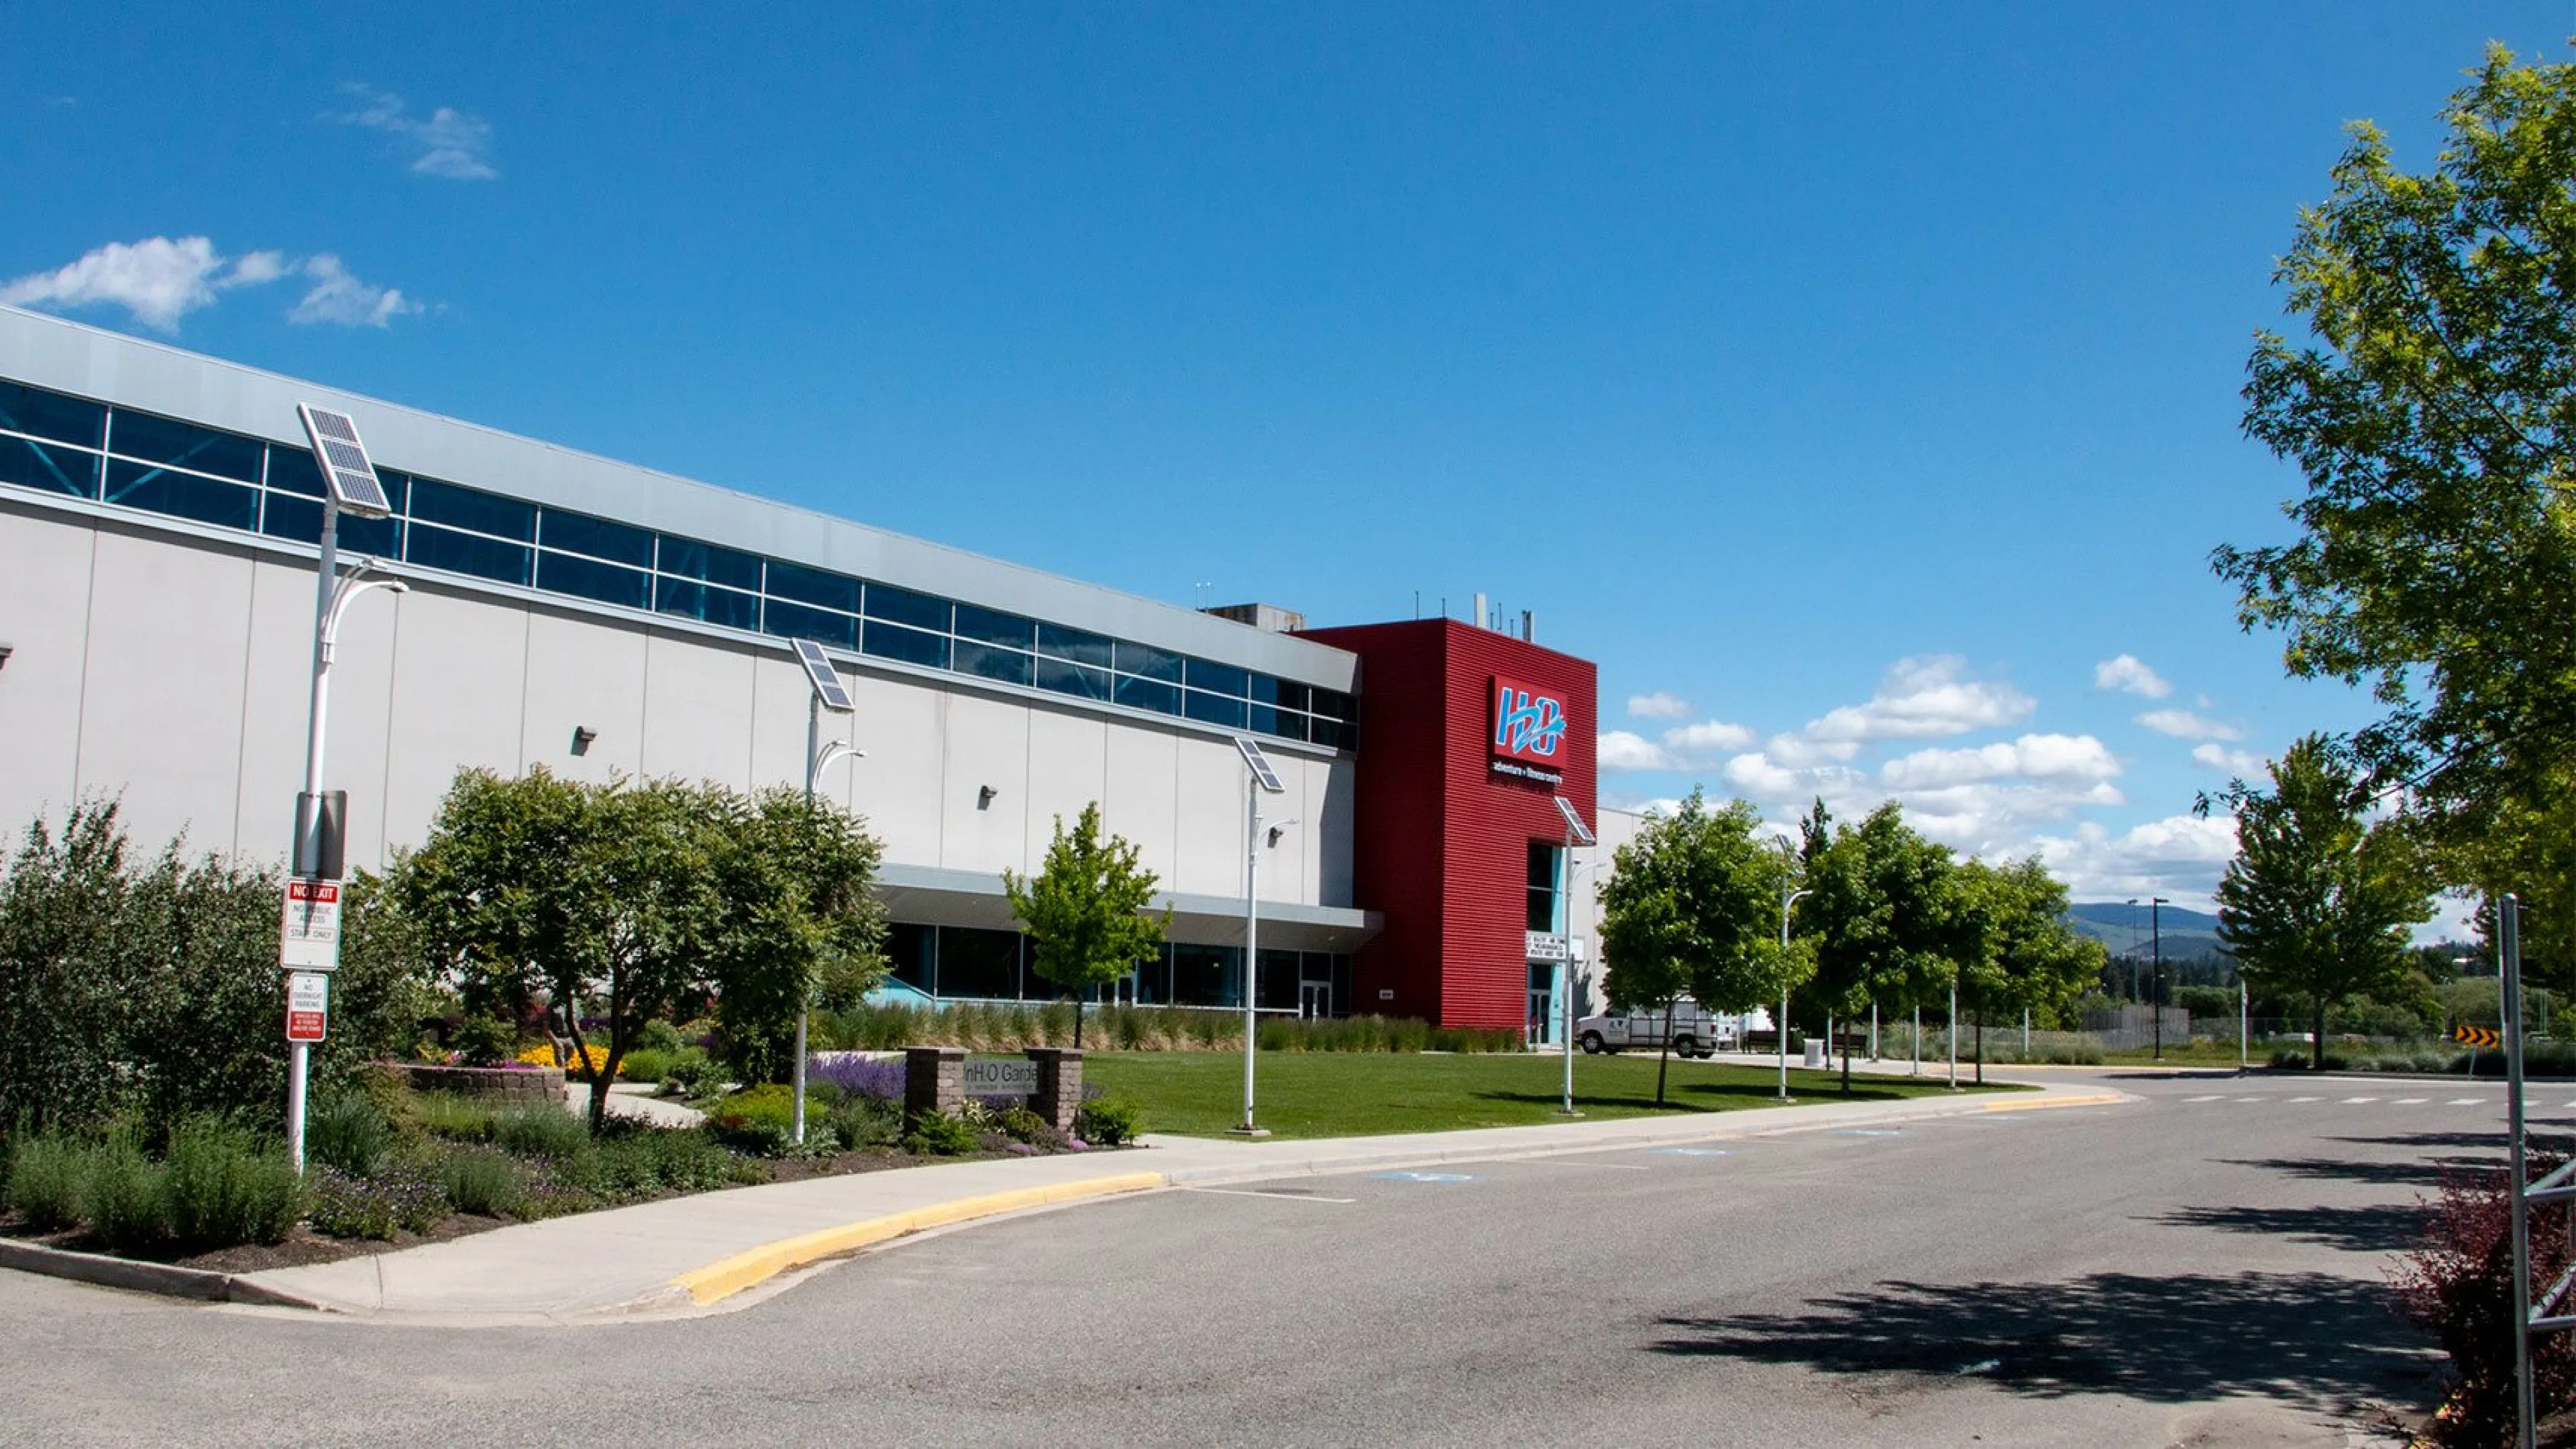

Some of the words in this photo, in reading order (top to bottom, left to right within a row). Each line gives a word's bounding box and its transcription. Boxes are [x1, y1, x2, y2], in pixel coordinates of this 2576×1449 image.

[293, 885, 309, 898] NO
[313, 886, 333, 900] EXIT
[307, 905, 331, 914] BLIC
[299, 915, 325, 924] AESS
[313, 930, 331, 939] ONLY
[1002, 1063, 1038, 1081] Garde
